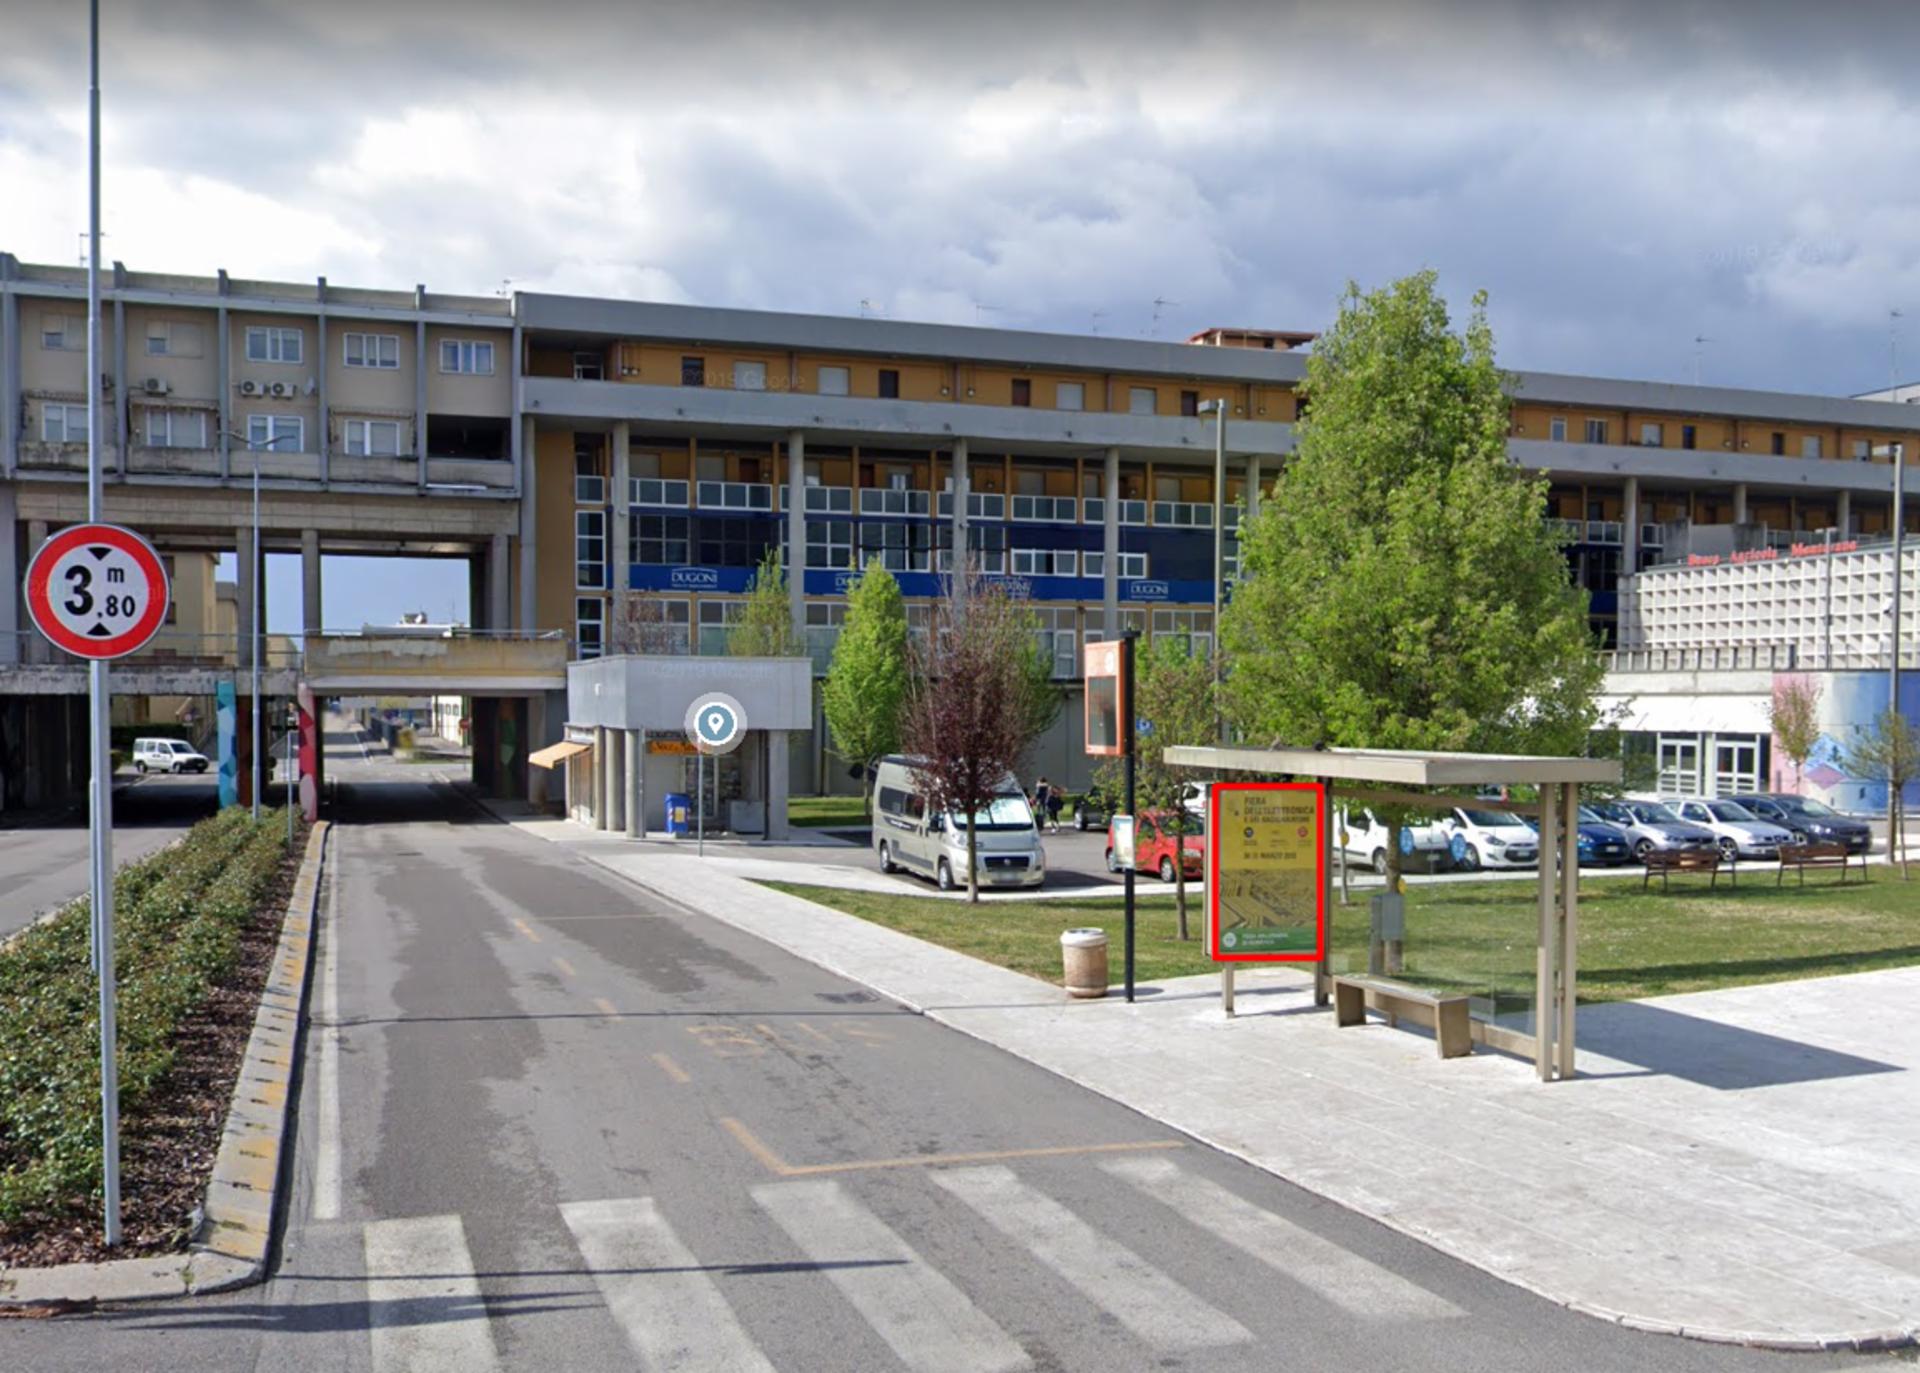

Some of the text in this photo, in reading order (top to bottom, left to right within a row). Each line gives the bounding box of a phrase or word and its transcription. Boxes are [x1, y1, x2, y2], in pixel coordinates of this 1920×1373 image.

[107, 567, 125, 583] m
[671, 572, 718, 583] DUGONI
[64, 564, 94, 616] 3
